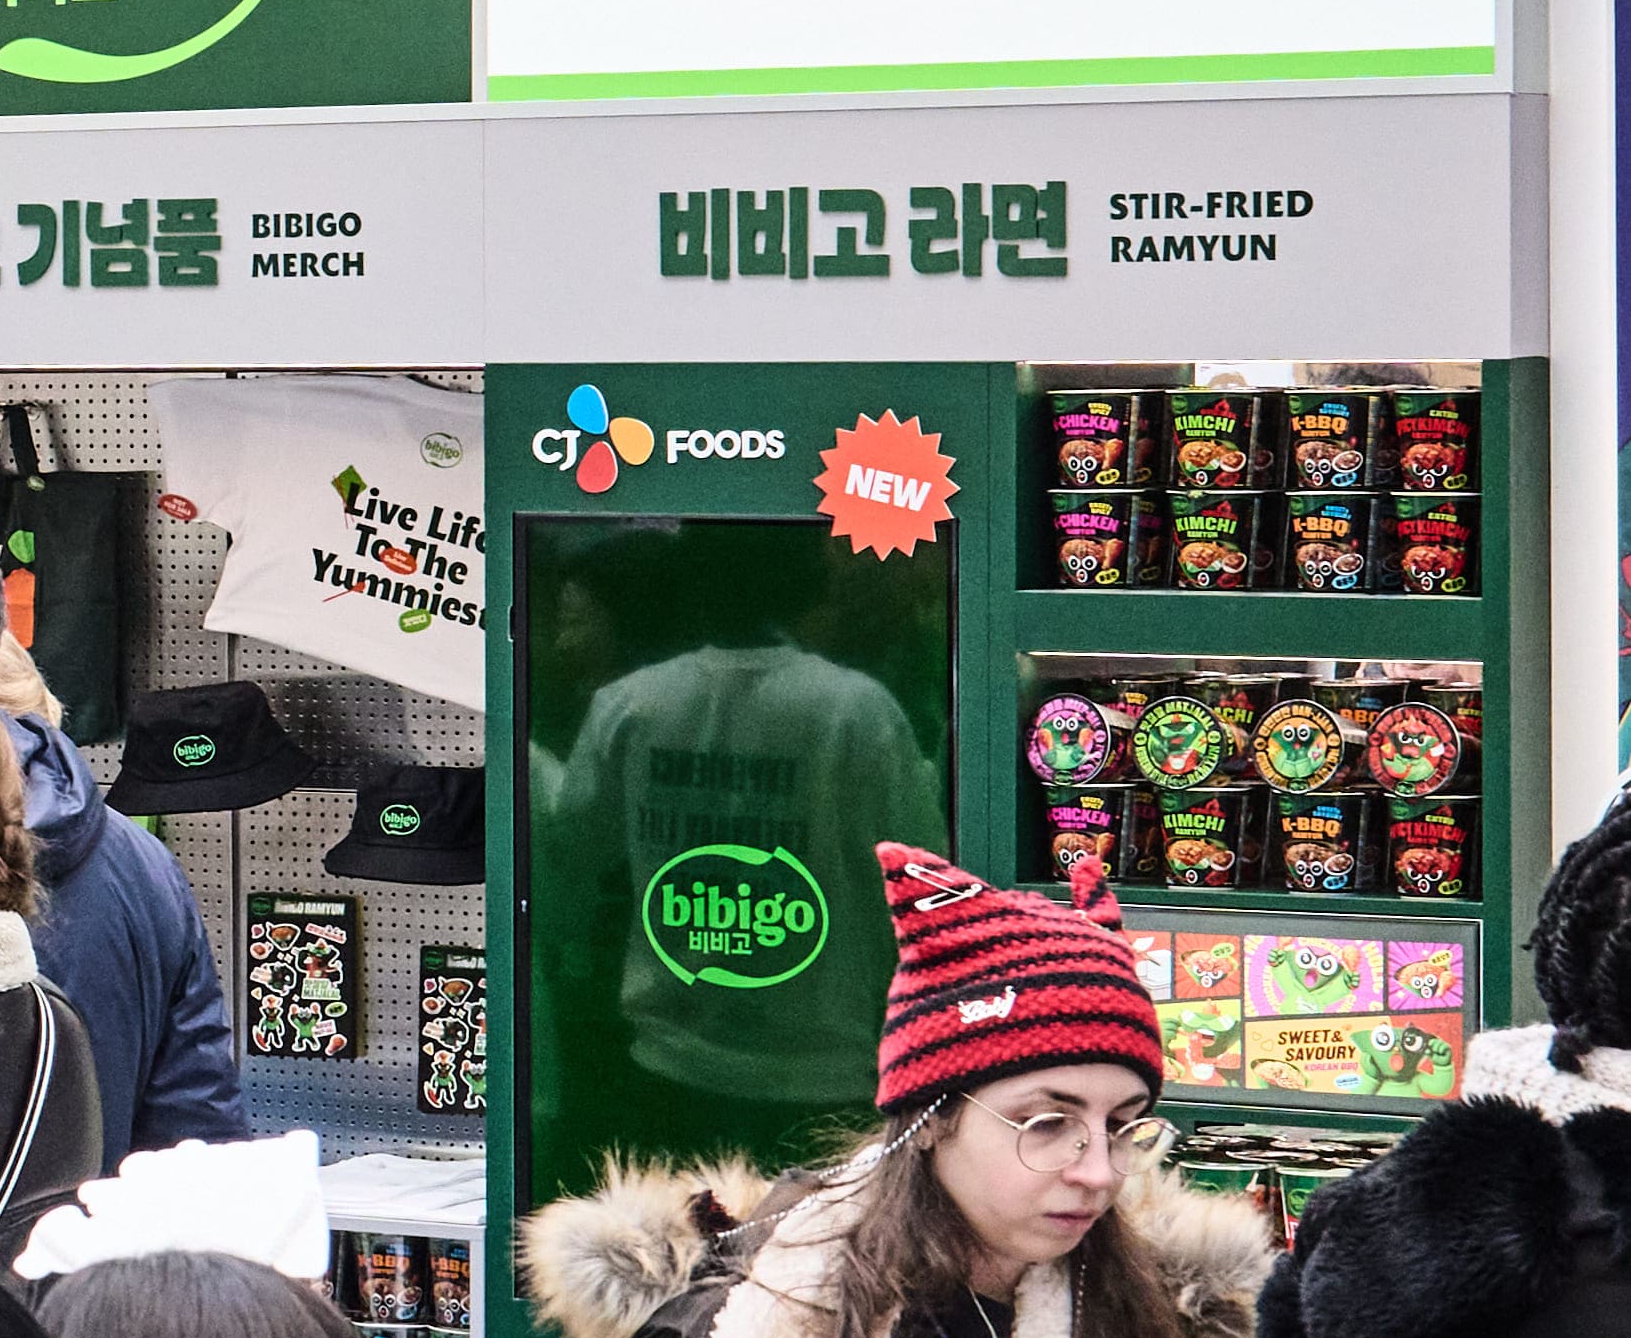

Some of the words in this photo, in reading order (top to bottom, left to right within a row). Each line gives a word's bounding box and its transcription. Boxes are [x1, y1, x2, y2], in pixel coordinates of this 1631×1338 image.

[1108, 188, 1314, 220] STIR-FRIED
[251, 212, 362, 238] BIBIGO
[658, 182, 890, 282] 비비고
[907, 178, 1068, 279] 라면
[17, 197, 223, 291] 기념품
[1109, 233, 1277, 262] RAMYUN
[251, 253, 365, 279] MERCH
[1174, 414, 1236, 433] KIMCHI
[1291, 415, 1349, 435] K-BBQ
[533, 428, 581, 471] CJ
[667, 429, 785, 462] FOODS
[845, 463, 932, 513] NEW
[345, 482, 417, 531] Live
[1175, 516, 1237, 534] KIMCHI
[1293, 517, 1350, 537] K-BBQ
[178, 742, 212, 757] bibigo
[384, 812, 418, 828] bibigo
[1163, 813, 1225, 832] KIMCHI
[1282, 817, 1340, 839] K-BBQ
[663, 882, 815, 947] bibigo
[689, 930, 752, 955] 비비고
[1285, 1046, 1357, 1063] SAVOURY
